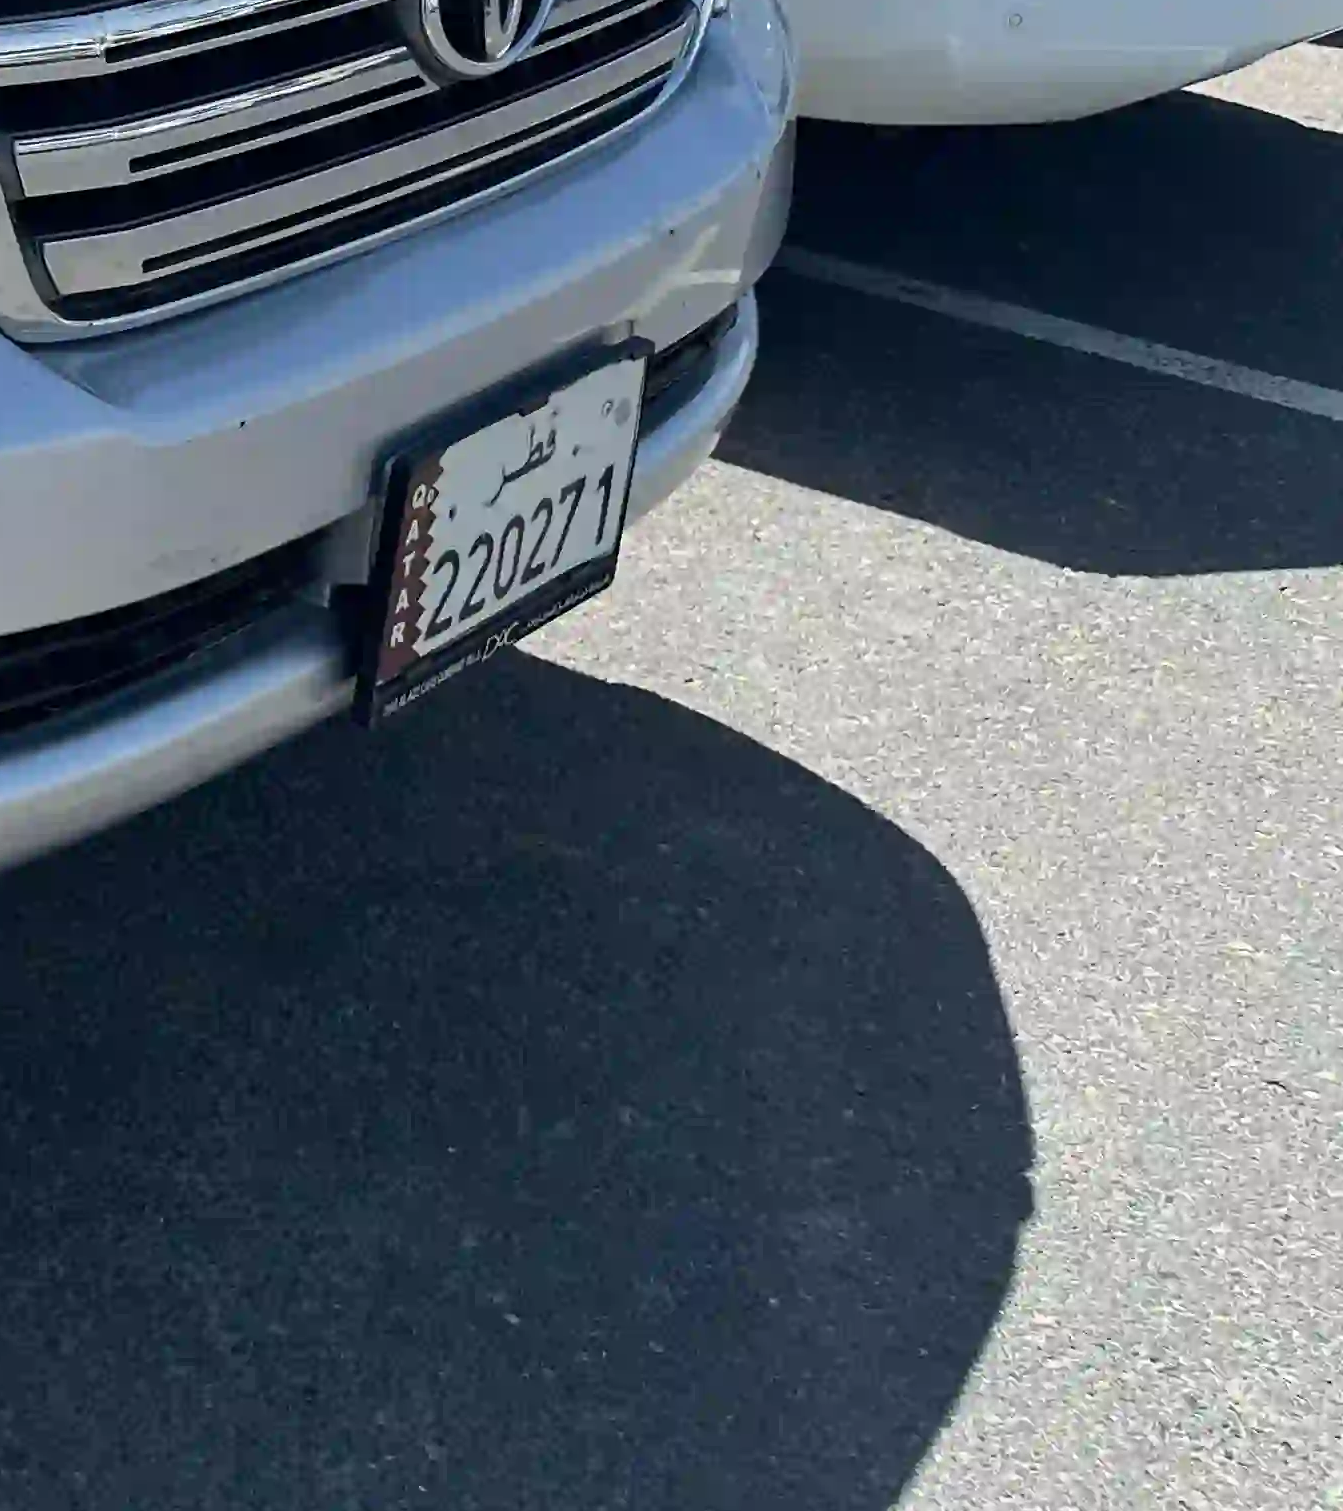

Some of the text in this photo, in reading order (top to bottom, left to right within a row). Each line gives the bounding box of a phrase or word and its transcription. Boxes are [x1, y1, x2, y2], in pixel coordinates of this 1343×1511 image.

[484, 408, 558, 507] قطر
[390, 482, 427, 649] QATAR
[422, 463, 615, 639] 220271
